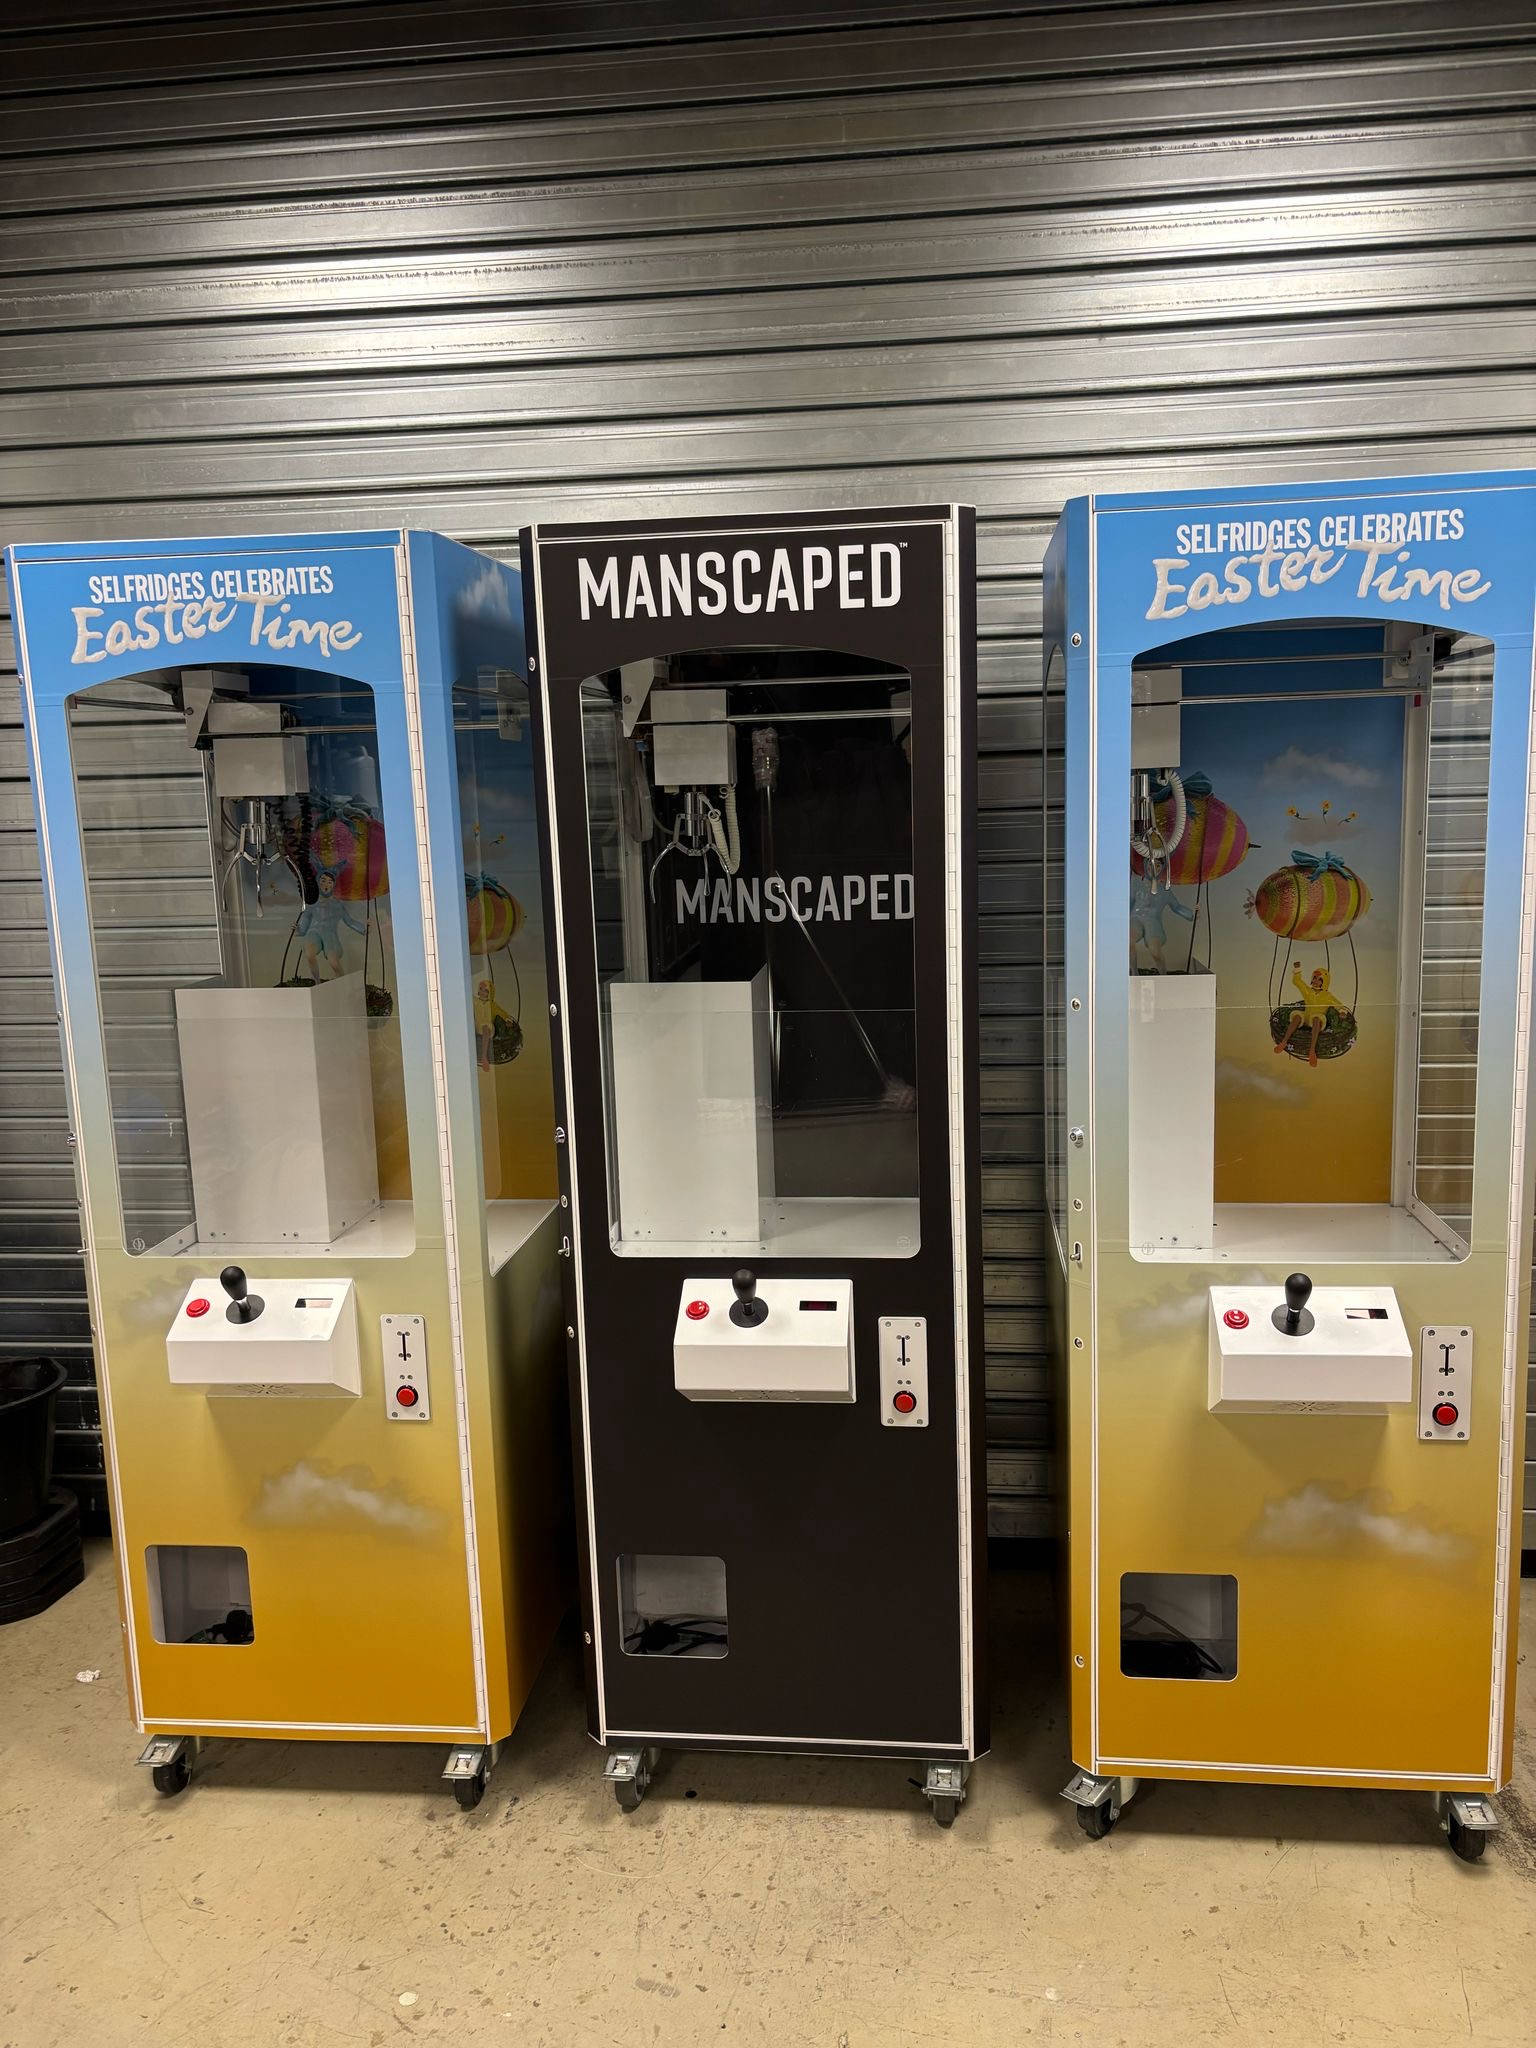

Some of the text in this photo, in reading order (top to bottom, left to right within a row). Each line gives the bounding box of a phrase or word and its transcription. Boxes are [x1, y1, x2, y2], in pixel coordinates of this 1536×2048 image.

[1176, 508, 1465, 555] SELFRIDGES CELEBRATES
[88, 566, 334, 604] SELFRIDGES CELEBRATES
[1144, 540, 1492, 621] Easter Time
[71, 591, 363, 664] Easter Time
[675, 873, 915, 924] MANSCAPED
